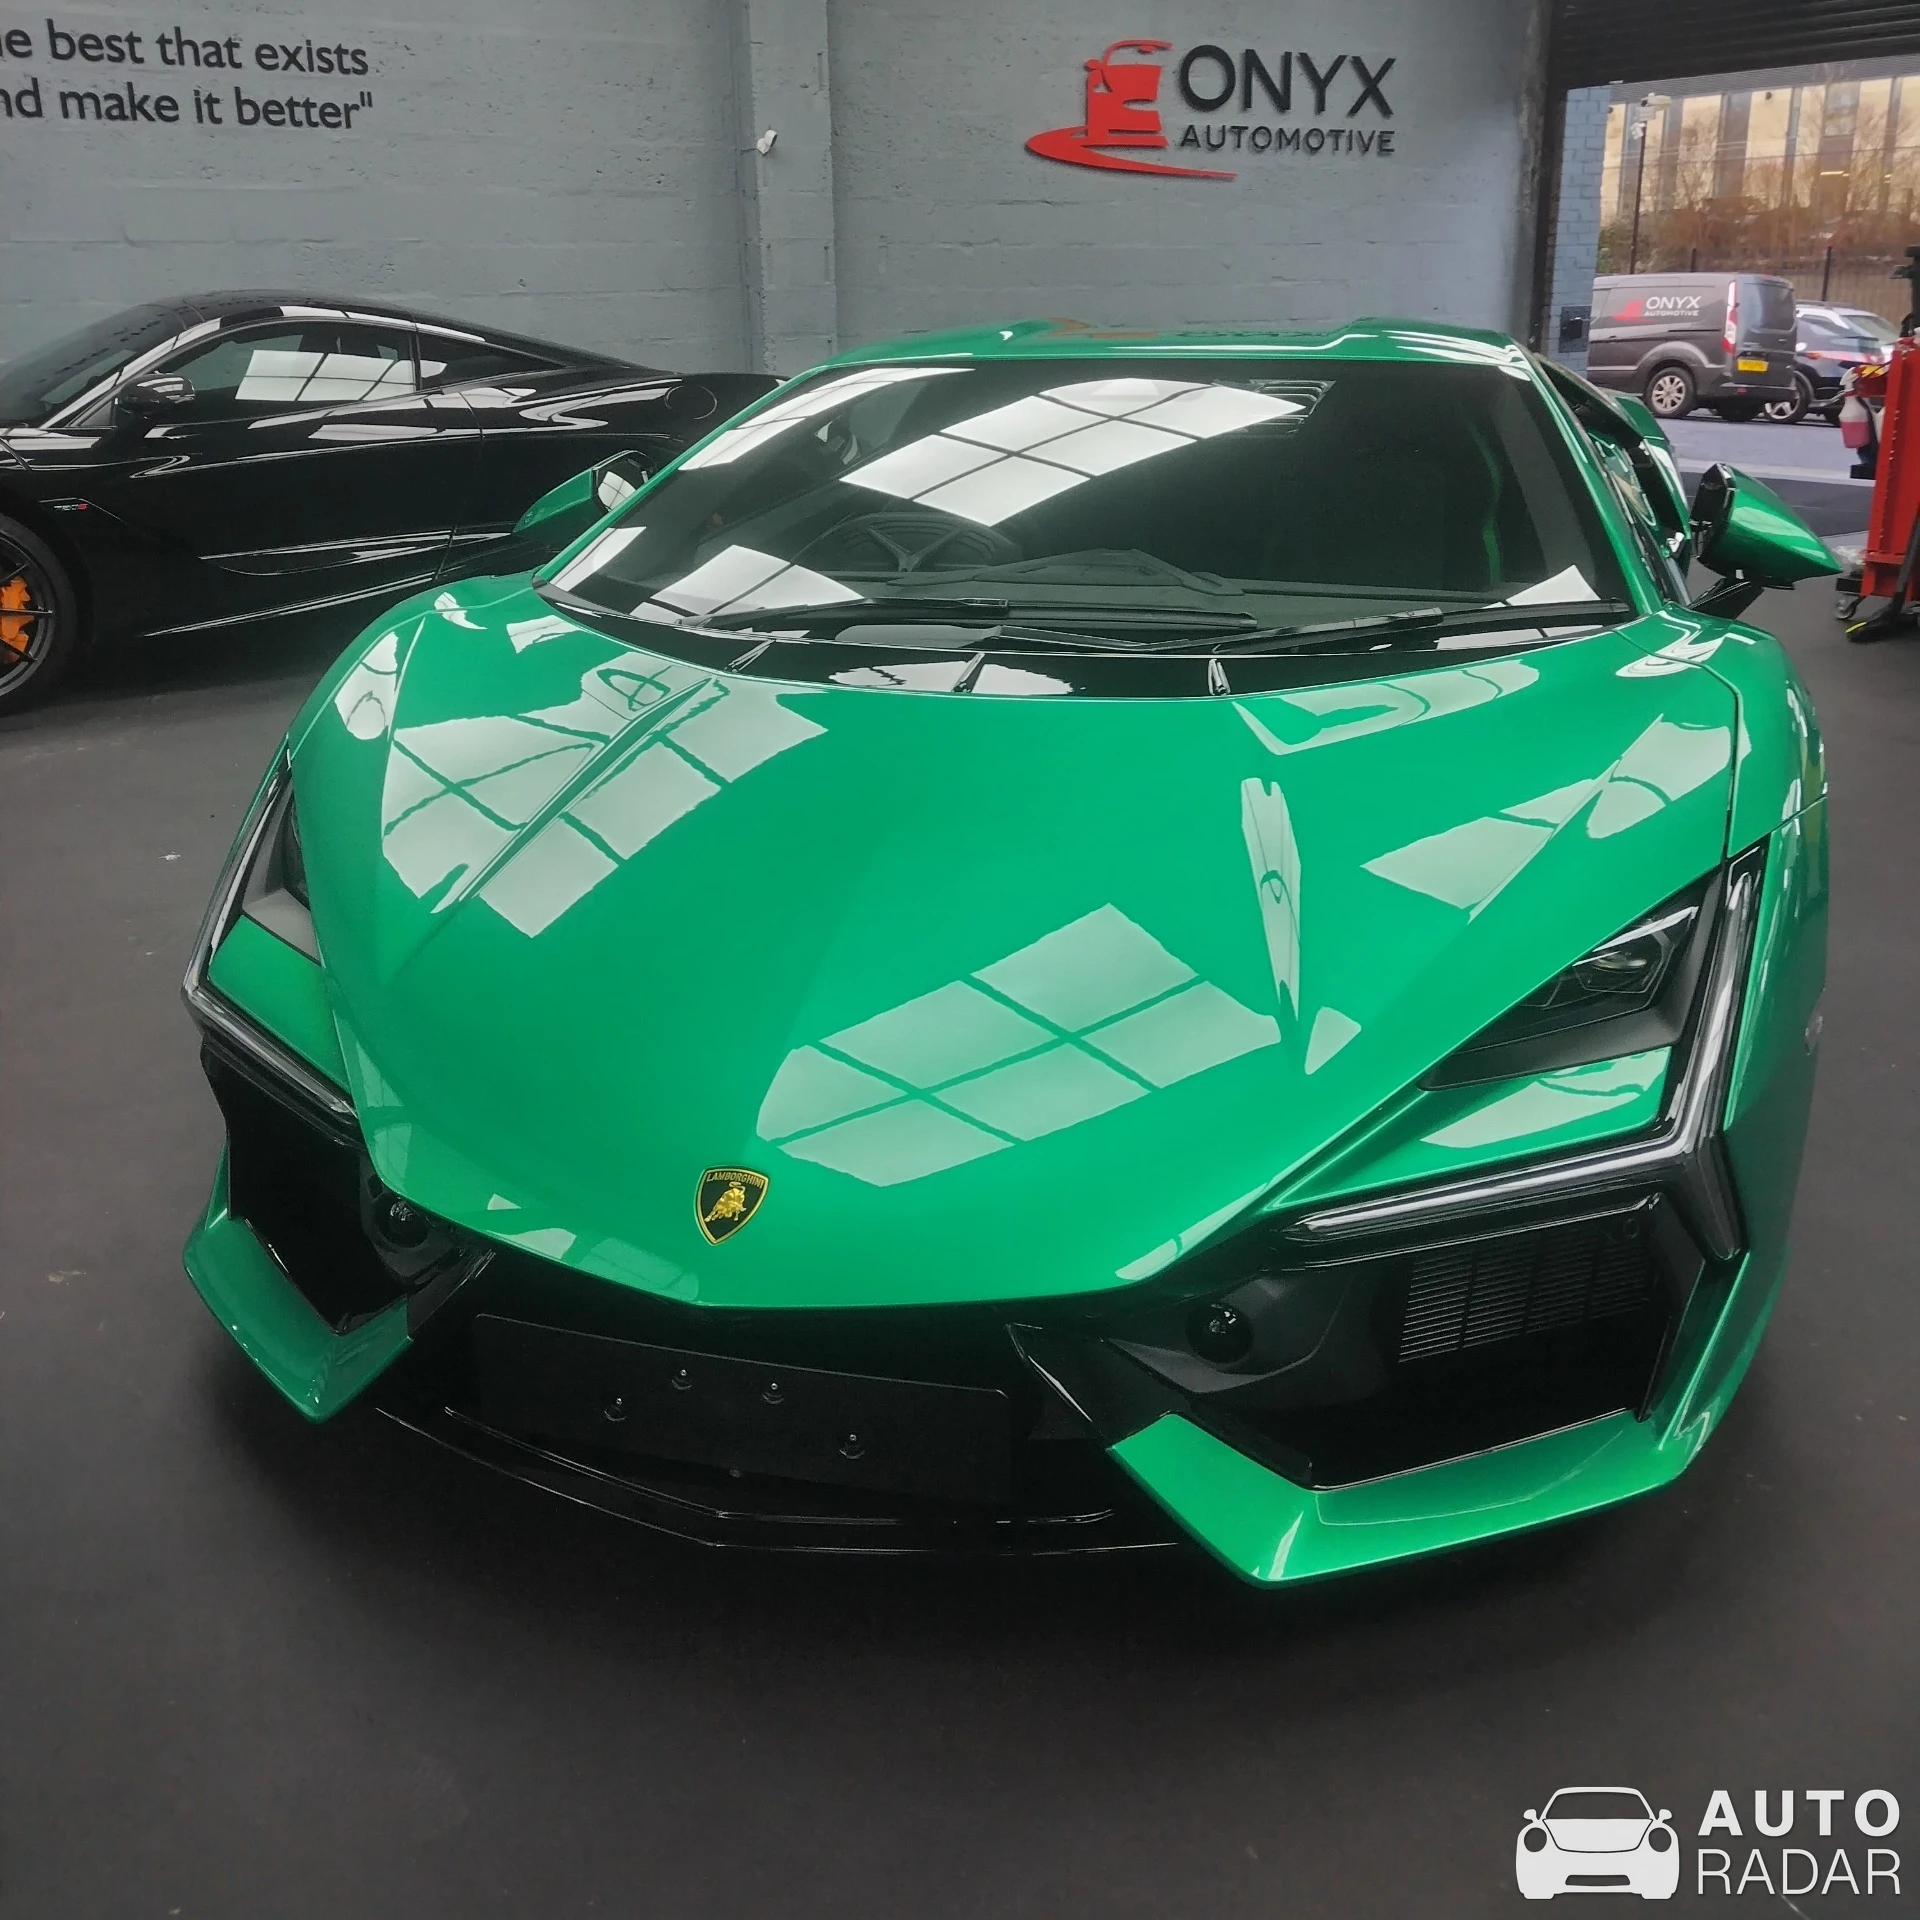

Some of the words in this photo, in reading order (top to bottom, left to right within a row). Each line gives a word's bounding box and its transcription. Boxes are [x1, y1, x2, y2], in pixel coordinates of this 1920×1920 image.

[0, 29, 32, 58] e
[46, 18, 144, 63] best
[155, 26, 242, 68] that
[254, 39, 368, 75] exists
[1180, 44, 1396, 118] ONYX
[59, 82, 179, 122] make
[193, 89, 222, 124] it
[234, 86, 373, 129] better"
[1180, 124, 1395, 154] AUTOMOTIVE
[1646, 296, 1701, 309] ONYX
[707, 1172, 764, 1188] LAMBORGHINI
